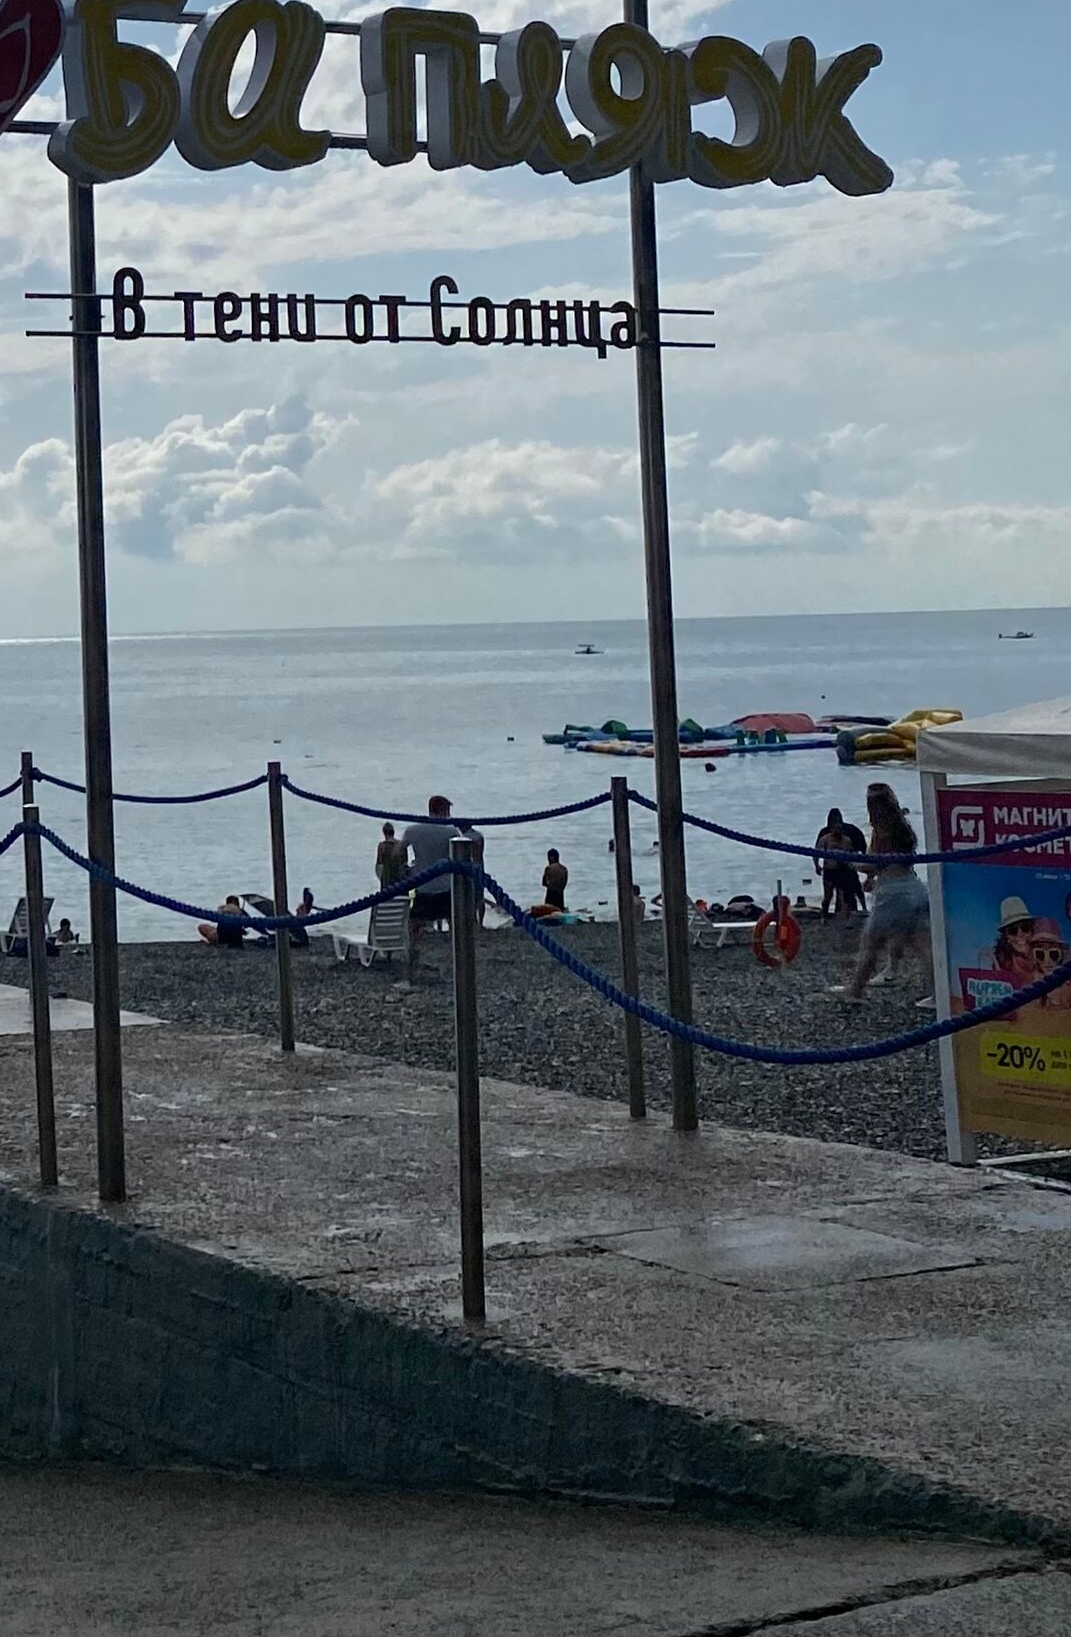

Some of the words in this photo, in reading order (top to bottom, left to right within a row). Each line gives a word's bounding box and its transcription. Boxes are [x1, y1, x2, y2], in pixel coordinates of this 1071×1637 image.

[113, 267, 146, 340] В
[174, 291, 316, 343] тени
[345, 294, 406, 344] от
[430, 275, 638, 359] Солнца
[992, 806, 1071, 827] МАГНИТ
[987, 1043, 1046, 1072] -20%
